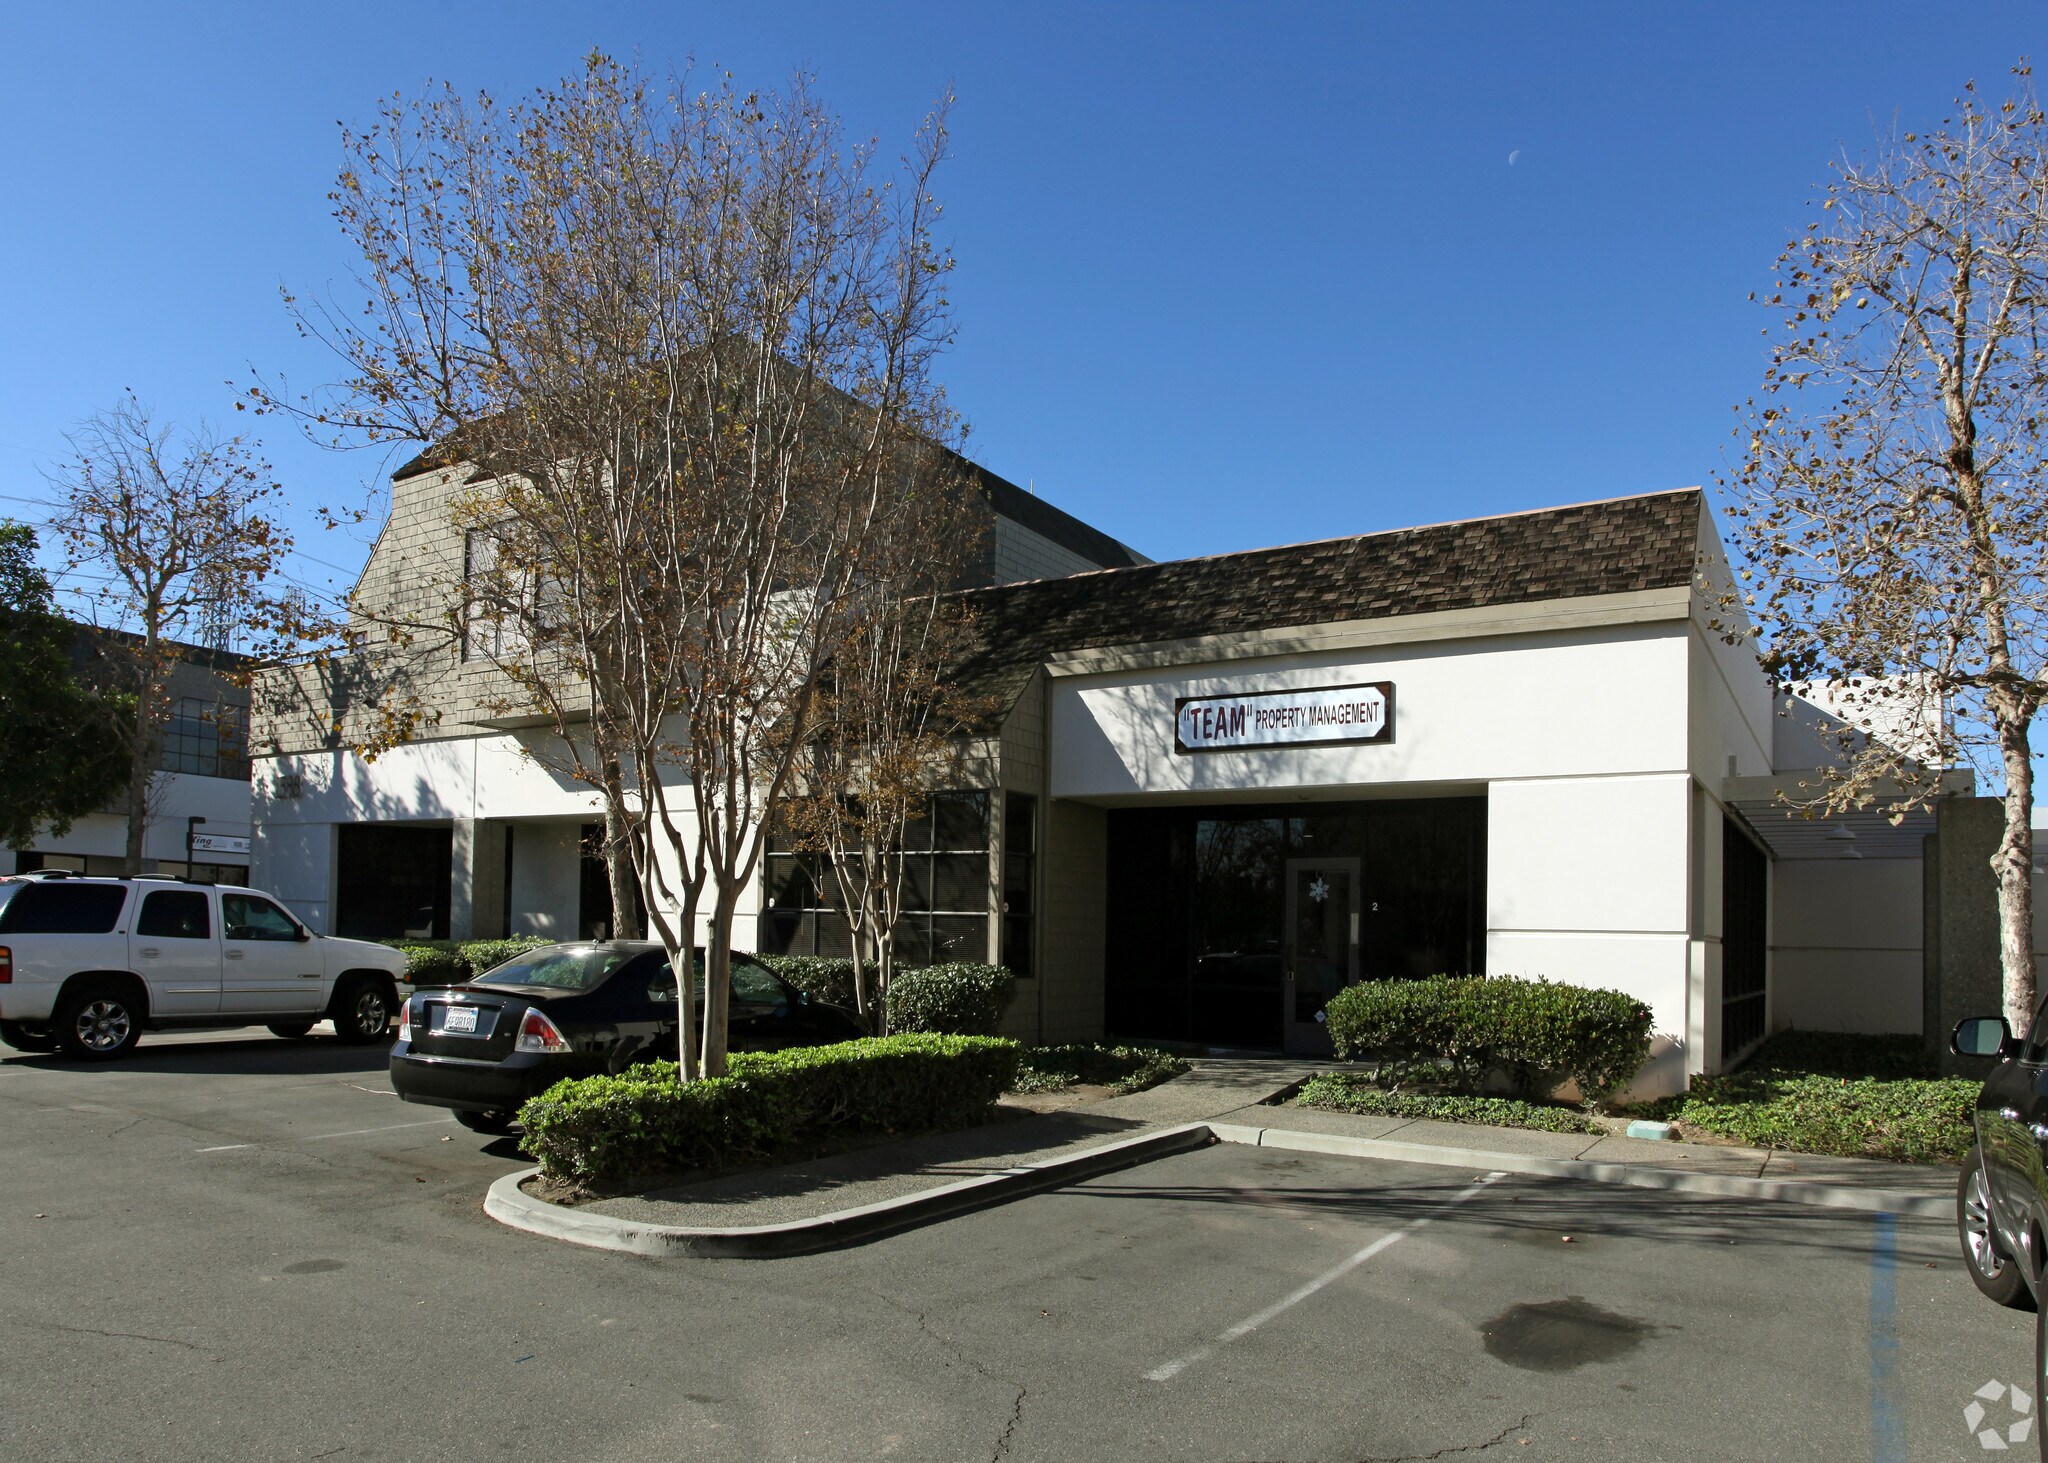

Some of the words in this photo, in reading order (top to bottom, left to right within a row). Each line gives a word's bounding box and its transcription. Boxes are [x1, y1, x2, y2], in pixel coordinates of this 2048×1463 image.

[1184, 704, 1253, 740] "TEAM"
[1255, 706, 1308, 730] PROPERTY
[1308, 701, 1380, 726] MANAGEMENT
[1372, 902, 1378, 911] 2
